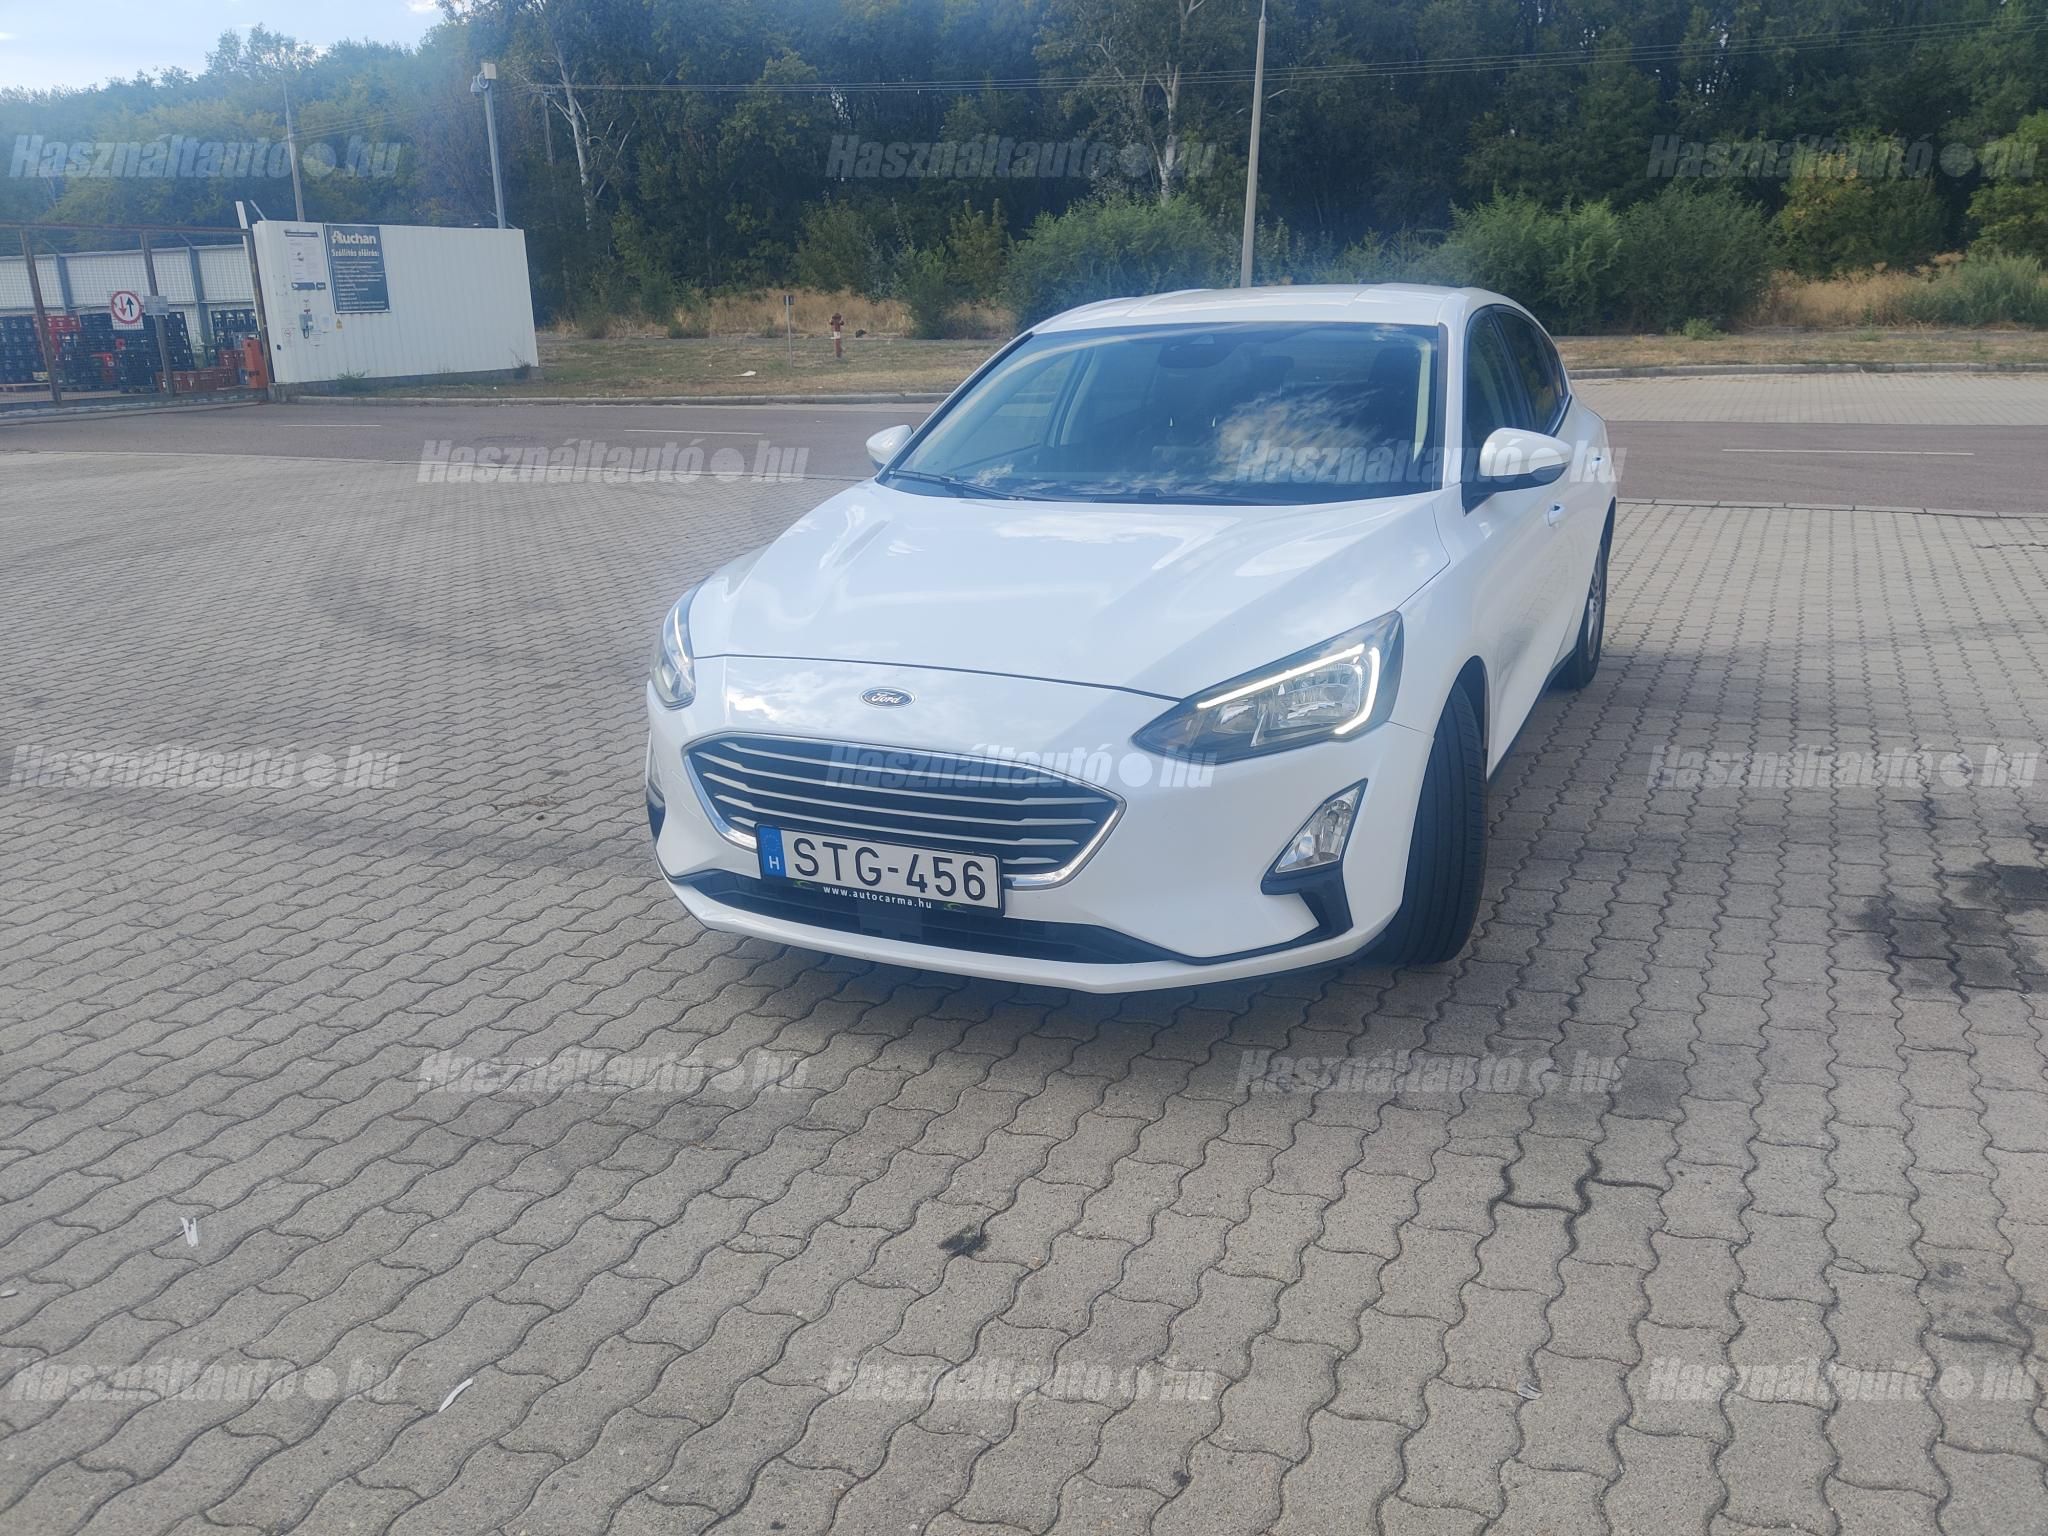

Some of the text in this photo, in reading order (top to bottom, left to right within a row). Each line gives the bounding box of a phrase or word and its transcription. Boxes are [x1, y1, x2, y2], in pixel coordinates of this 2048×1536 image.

[331, 230, 377, 245] Auchan
[871, 693, 903, 704] Ford
[768, 837, 986, 901] H STG-456
[823, 886, 932, 909] www.autocarma.hu
